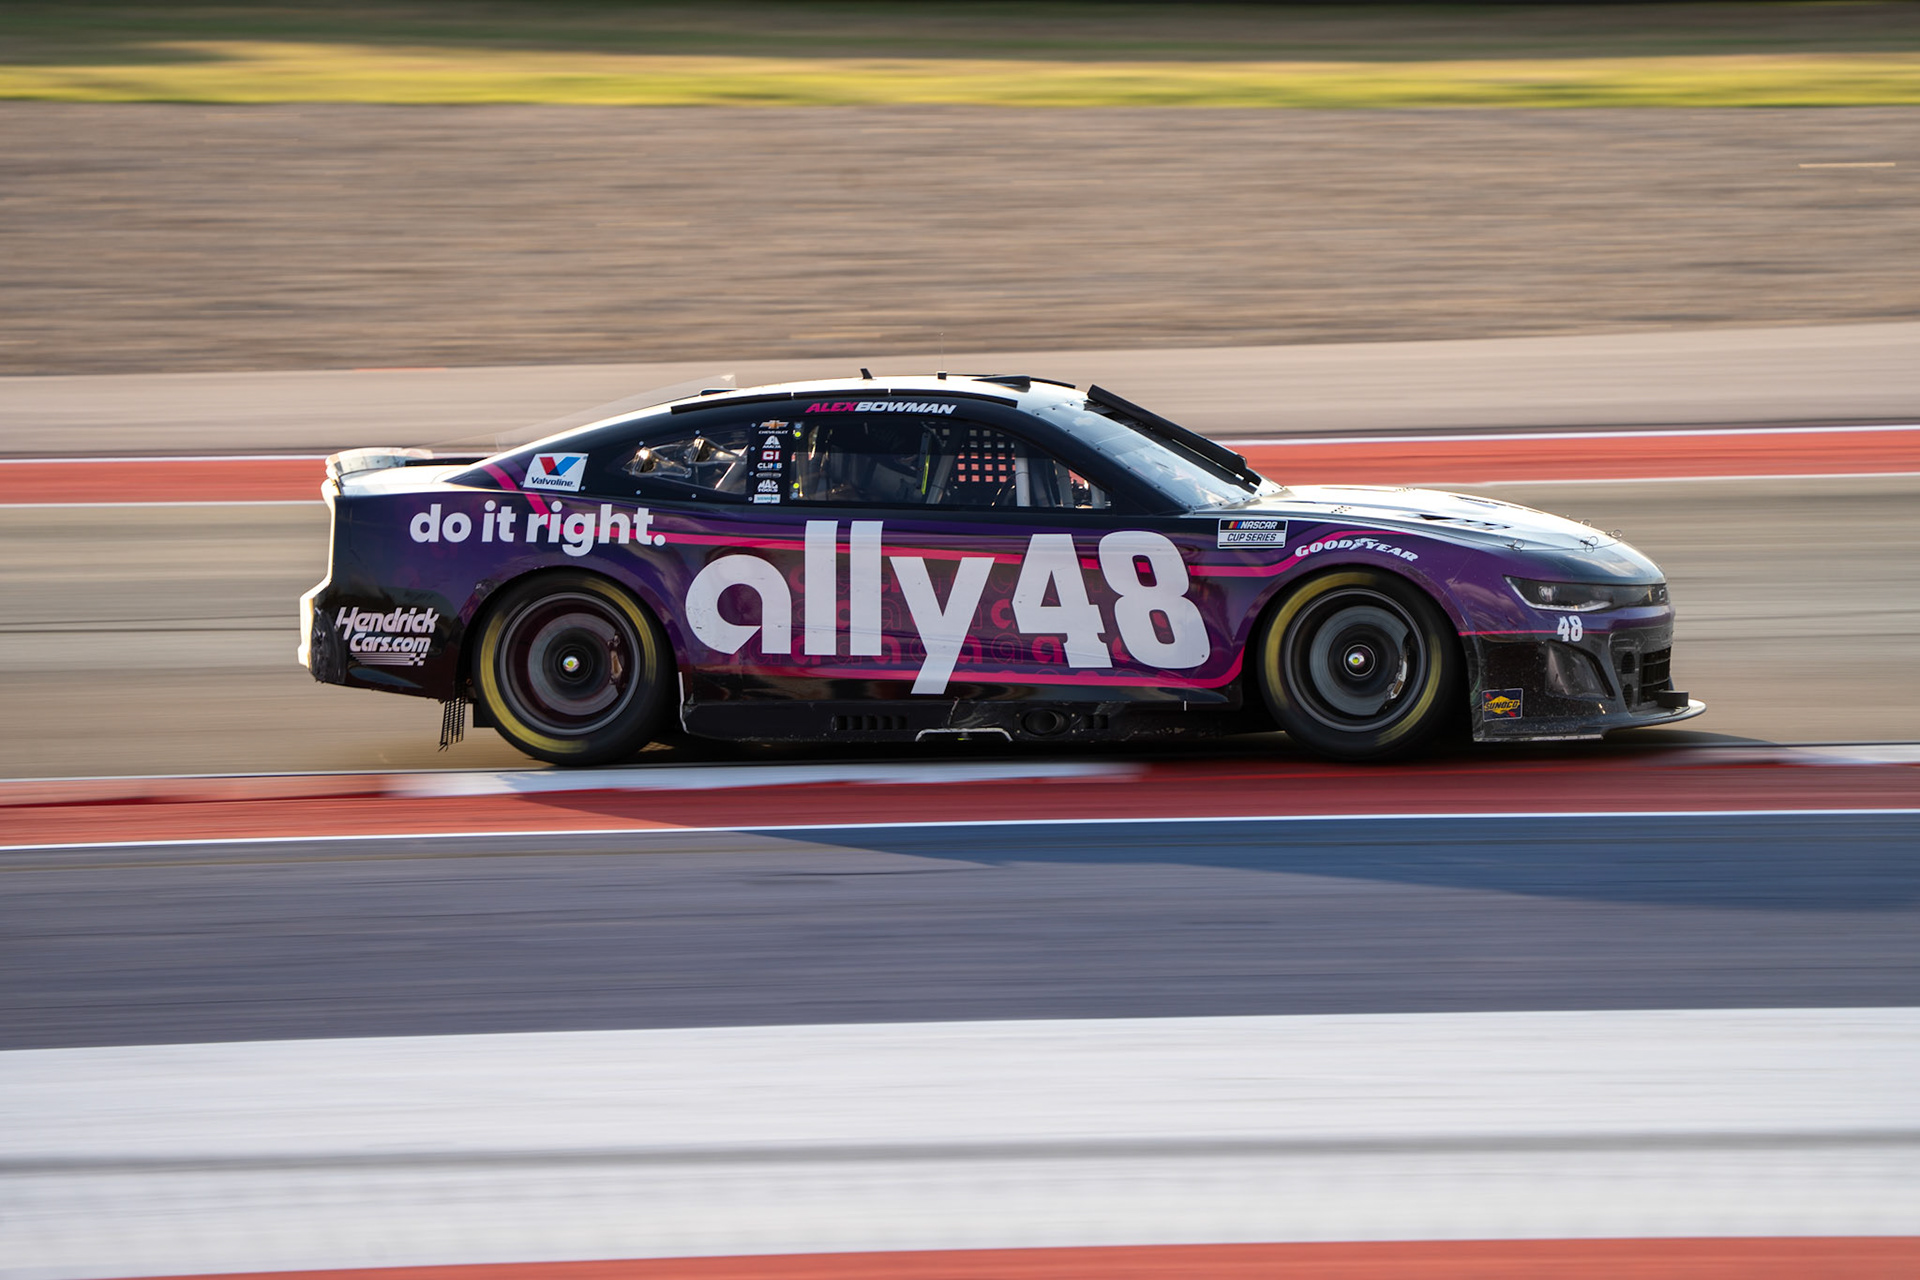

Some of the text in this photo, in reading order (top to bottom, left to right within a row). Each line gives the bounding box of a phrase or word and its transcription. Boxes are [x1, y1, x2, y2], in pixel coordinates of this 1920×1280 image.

[531, 476, 574, 488] Valvoline
[410, 500, 666, 557] do it right.
[1240, 521, 1278, 530] NASCAR
[1227, 533, 1277, 542] CUP SERIES
[1295, 537, 1419, 562] GOODYEAR
[685, 520, 1211, 695] ally 48
[335, 606, 439, 640] Hendrick
[1557, 615, 1583, 642] 48
[350, 632, 431, 653] Cars.com
[1485, 701, 1519, 711] SUNOCO
